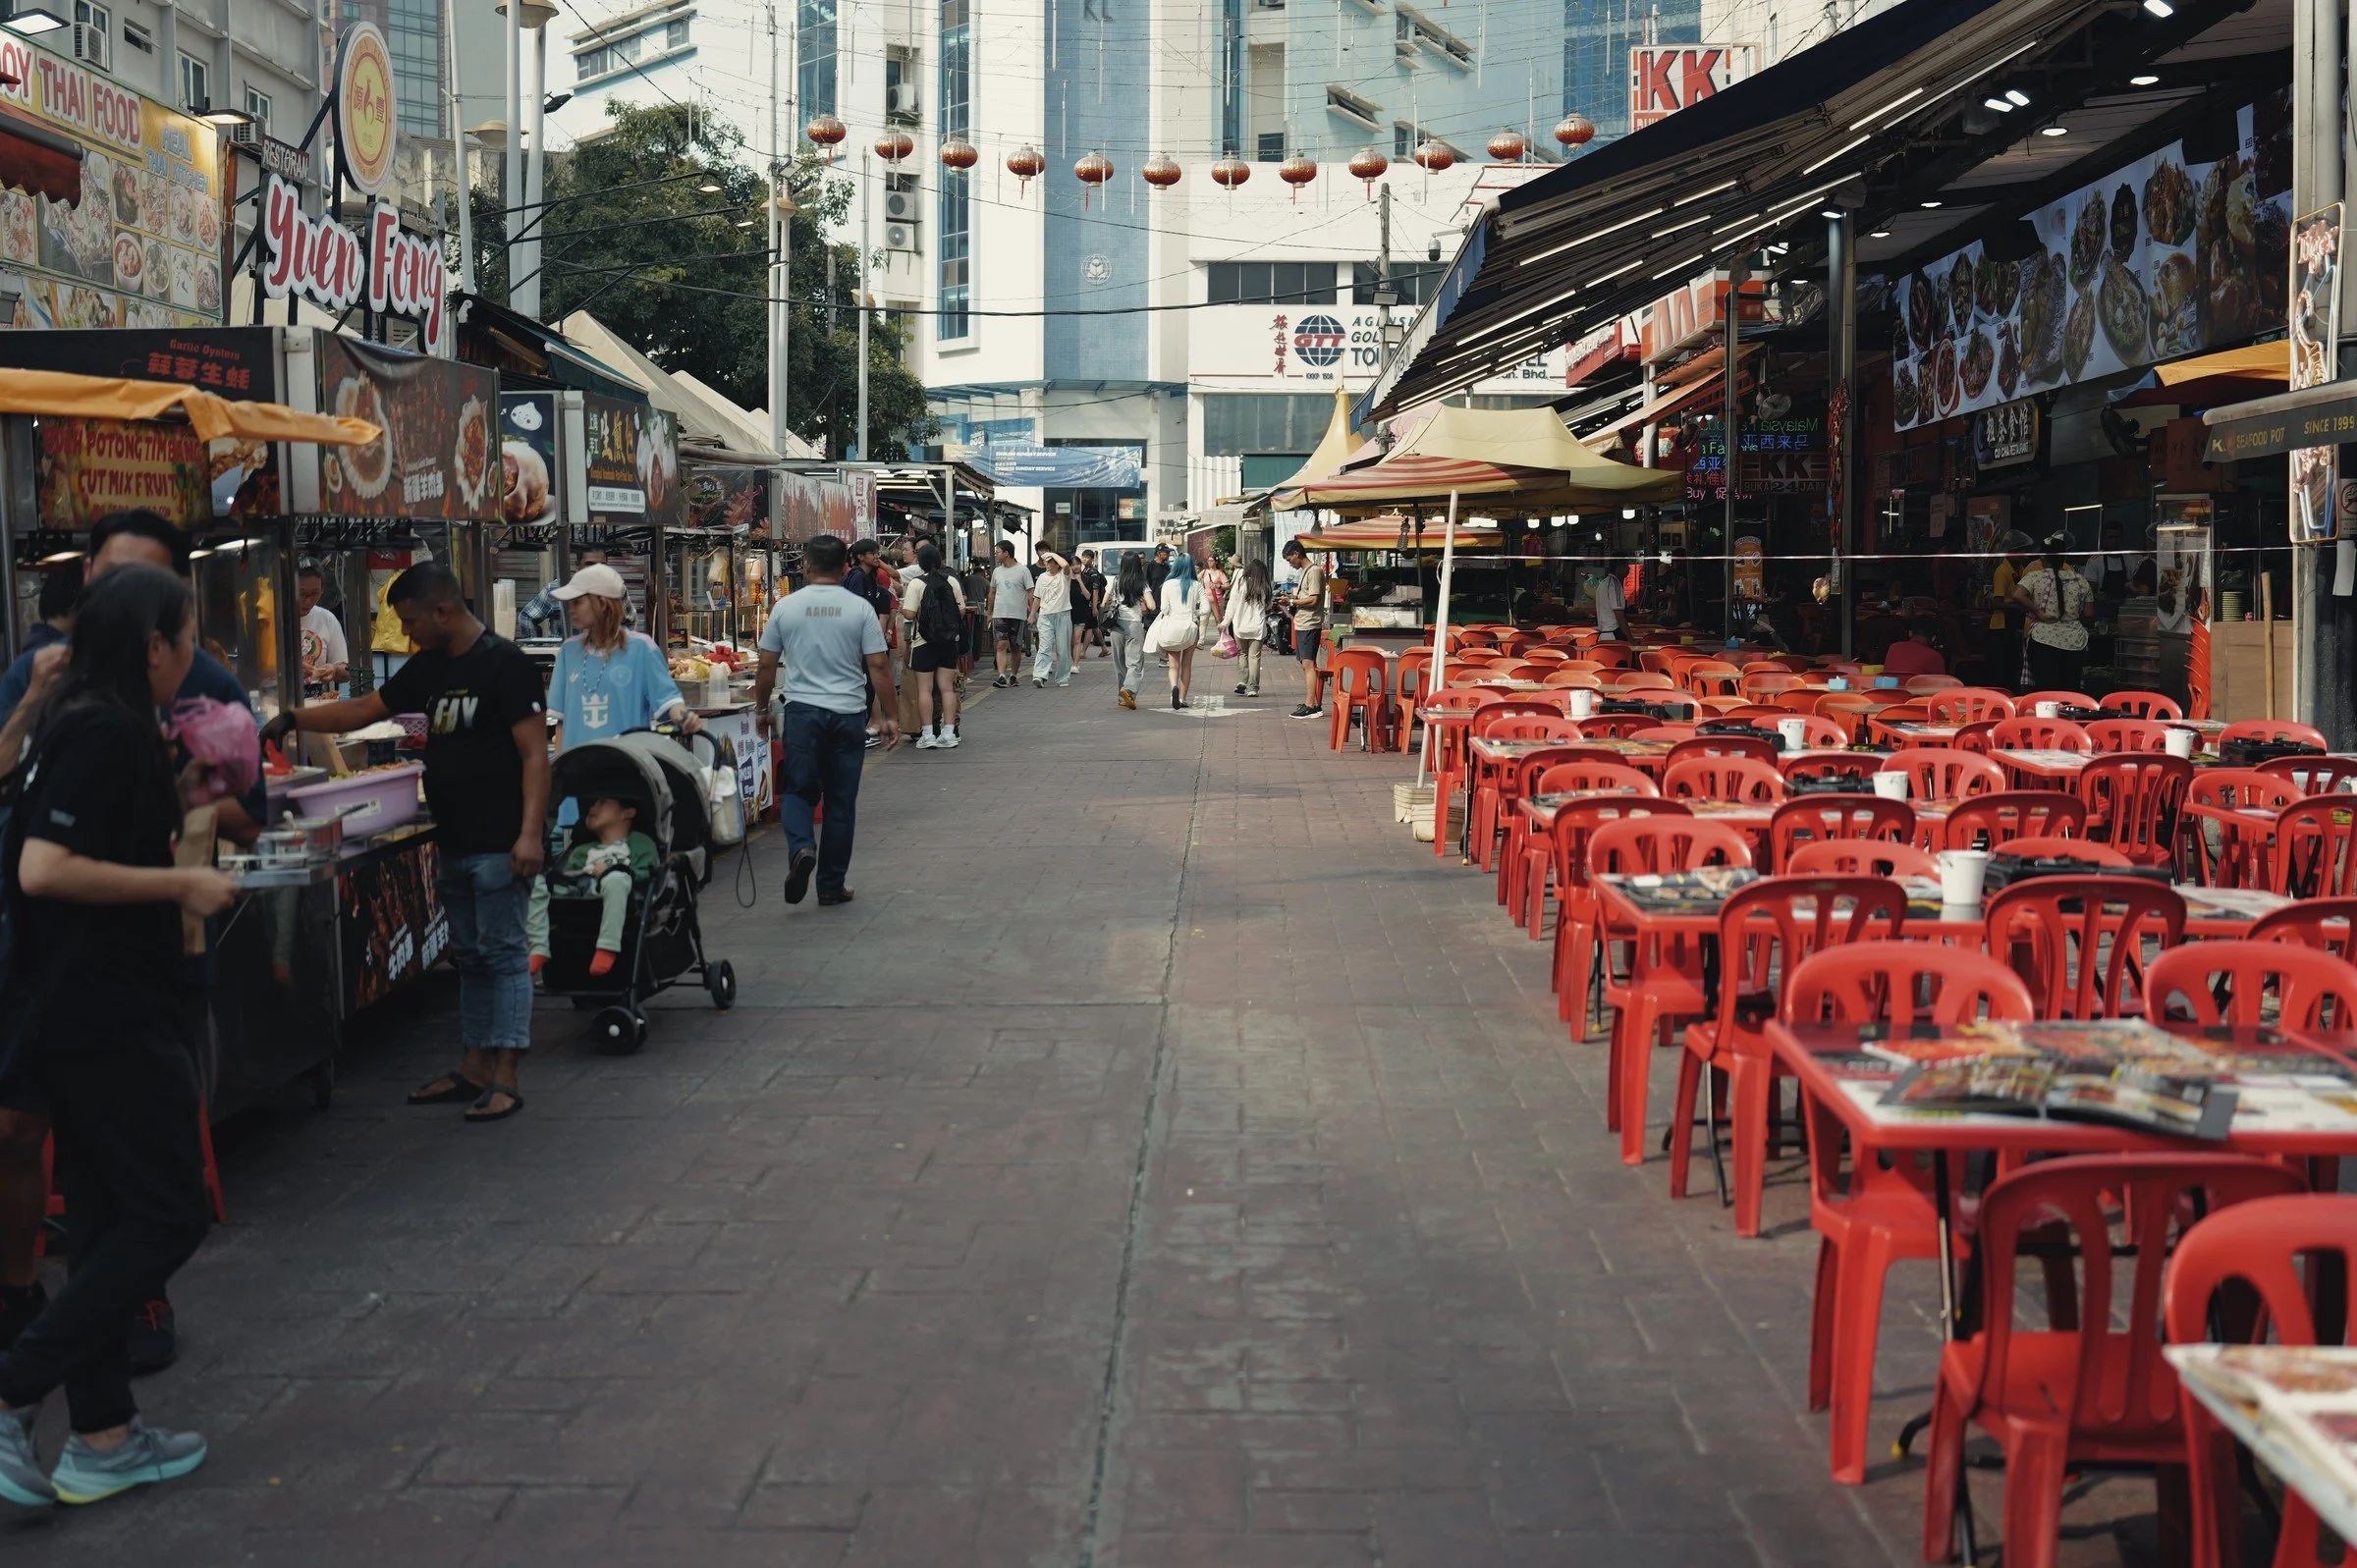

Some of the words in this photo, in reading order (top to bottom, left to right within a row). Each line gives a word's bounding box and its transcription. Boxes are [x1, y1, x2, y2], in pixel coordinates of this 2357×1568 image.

[1639, 50, 1723, 110] KK
[38, 56, 86, 123] THAI
[92, 81, 141, 144] FOOD
[162, 126, 193, 164] REAL
[263, 138, 309, 180] RESTORAN
[146, 147, 168, 178] THAI
[172, 159, 209, 195] KITCHEN
[269, 184, 361, 298] Yuen
[373, 211, 442, 345] Fong
[170, 338, 200, 353] Garlic
[202, 345, 242, 360] Oysters
[1293, 334, 1346, 348] GTT
[1522, 369, 1549, 379] Bhd.
[86, 430, 142, 463] POTONG
[2236, 430, 2269, 449] SEAFOOD
[2271, 426, 2286, 443] POT
[2304, 418, 2330, 435] SINCE
[2332, 414, 2356, 431] 1999
[78, 468, 106, 495] CUT
[110, 468, 132, 498] MIX
[136, 469, 178, 499] FRUIT
[1743, 481, 1772, 493] BUKA
[1772, 480, 1799, 493] 24
[1800, 481, 1825, 493] JAM
[805, 606, 843, 618] AARON
